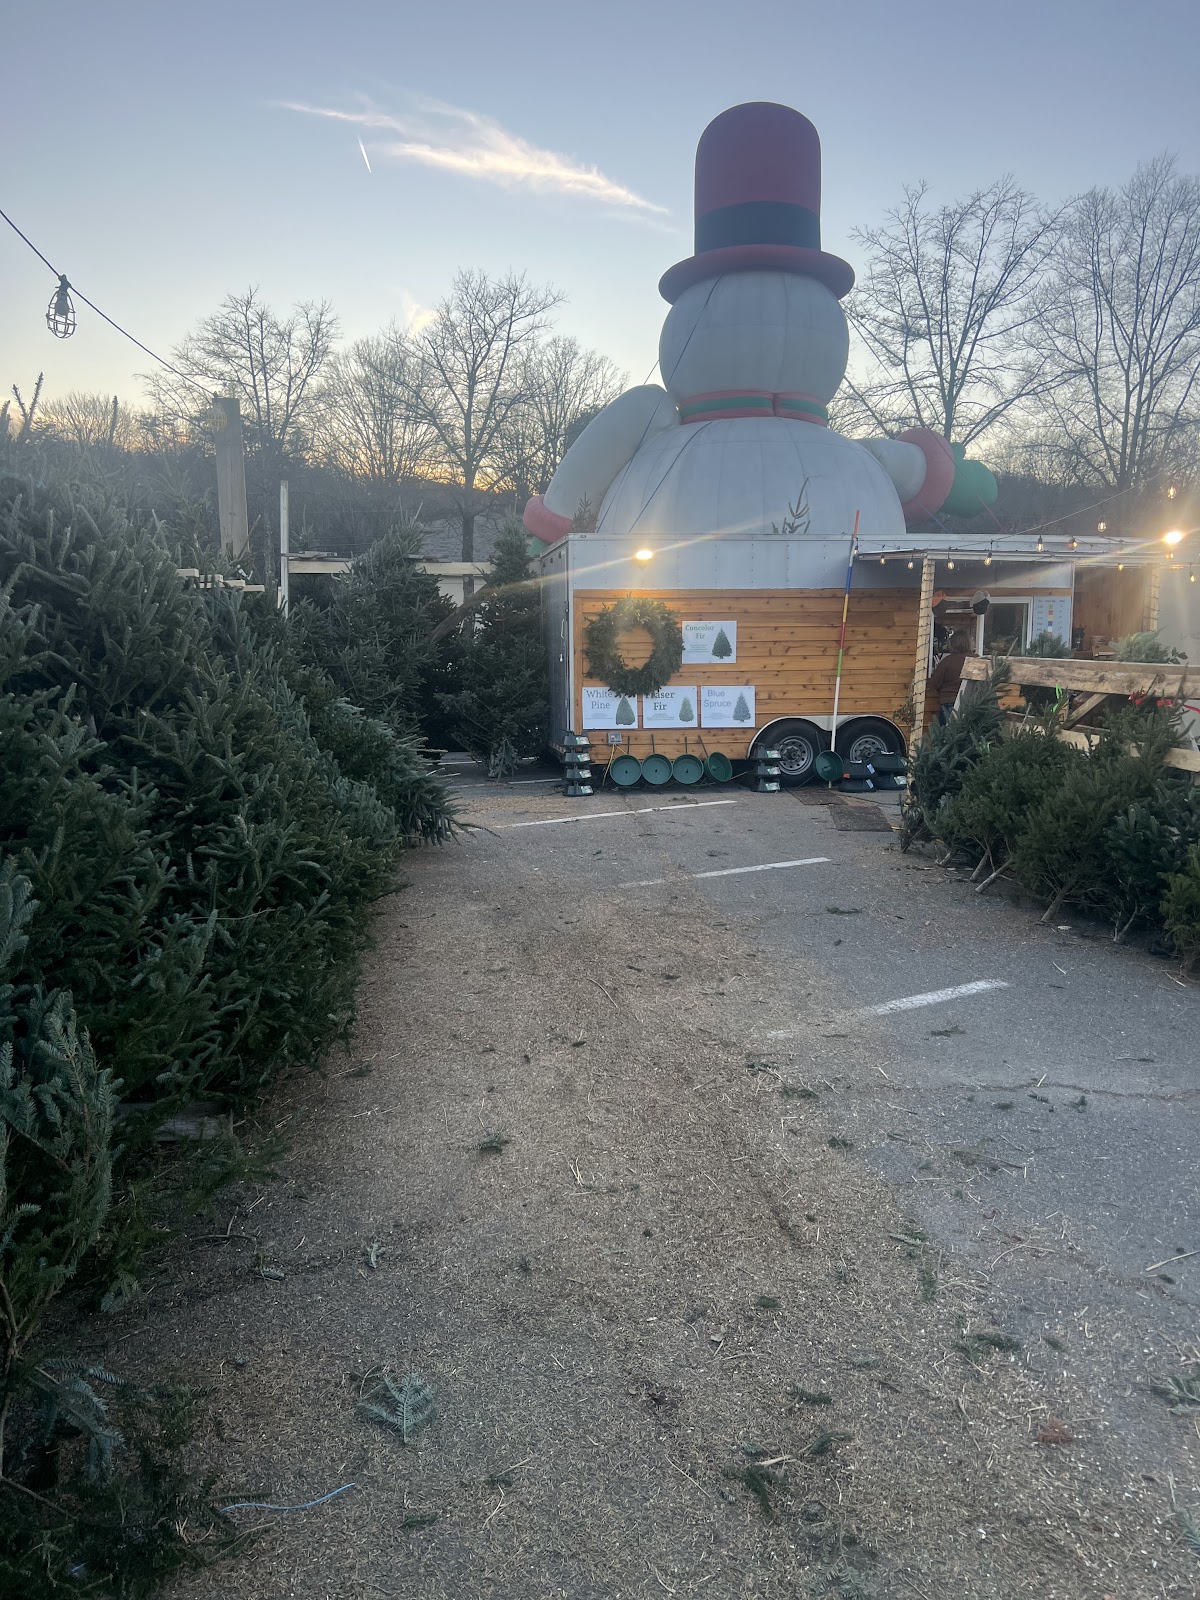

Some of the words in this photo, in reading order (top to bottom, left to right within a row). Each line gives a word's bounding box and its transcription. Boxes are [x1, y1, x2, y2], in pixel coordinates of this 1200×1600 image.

[586, 689, 613, 698] White
[707, 689, 725, 697] Blue
[591, 700, 611, 709] Pine
[653, 702, 667, 711] Fir
[703, 699, 732, 708] Spruce
